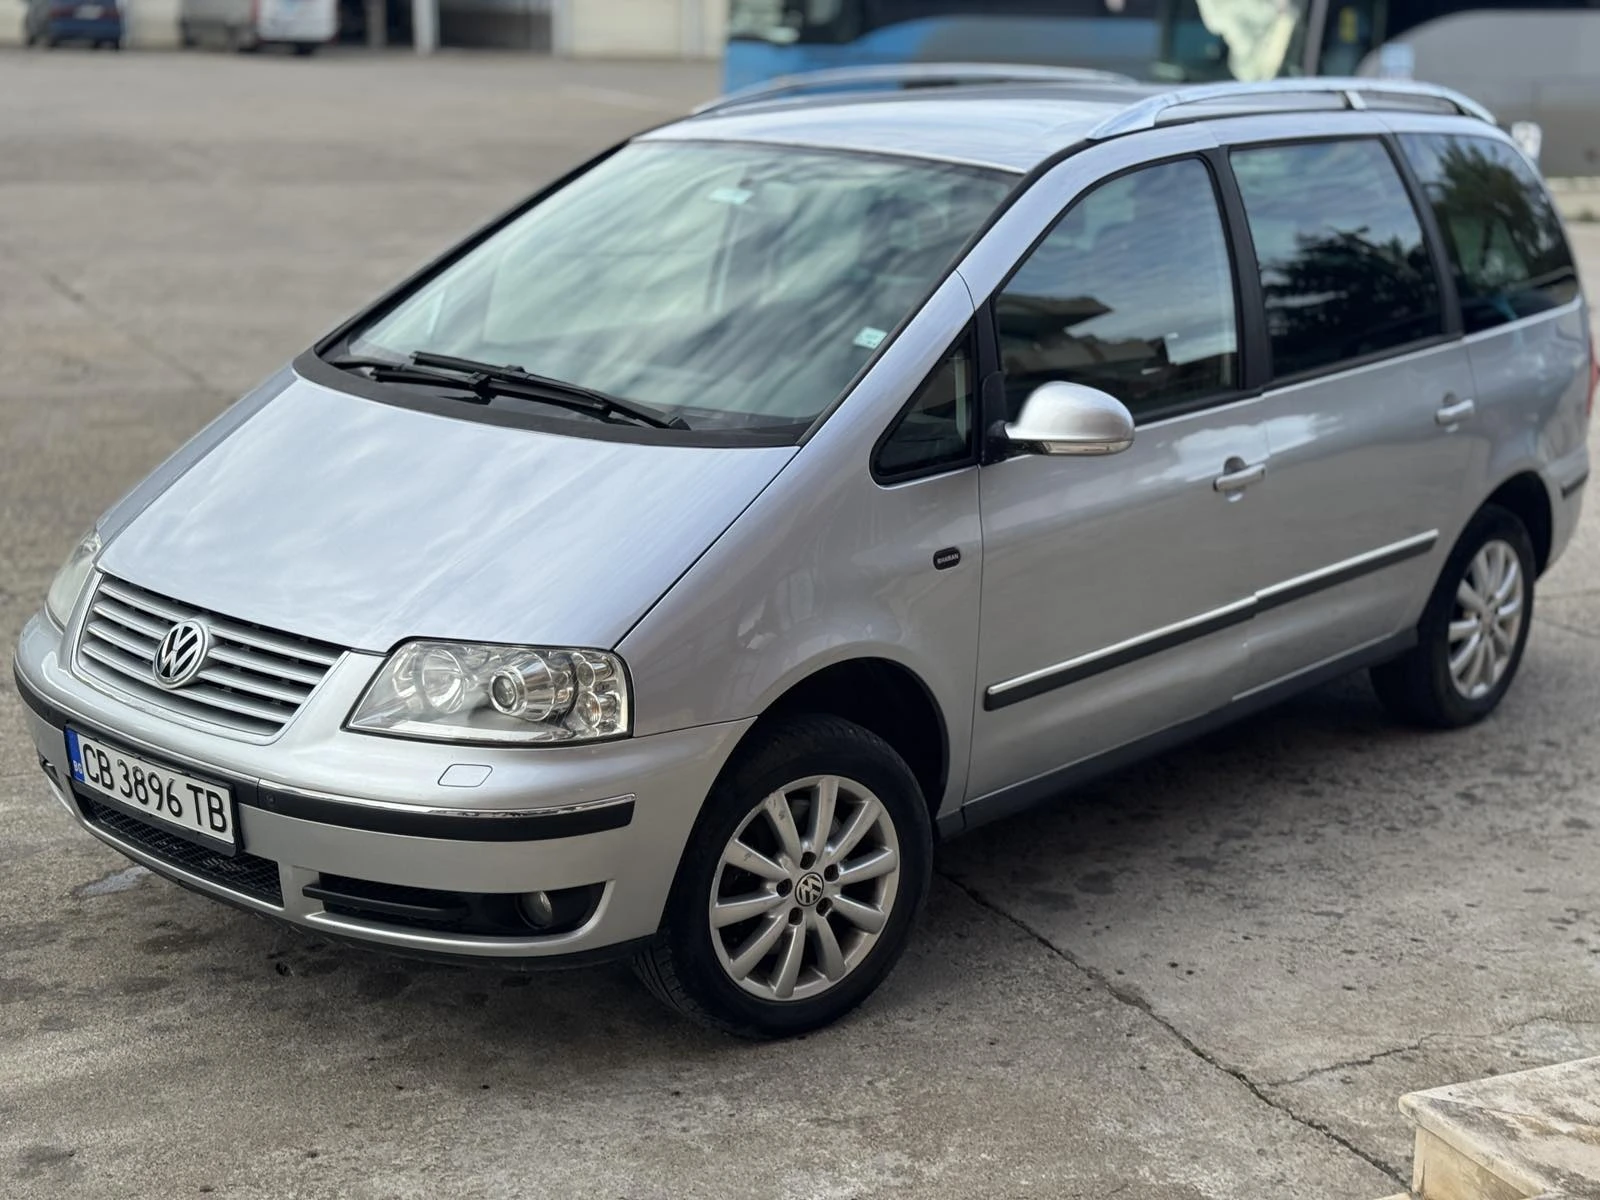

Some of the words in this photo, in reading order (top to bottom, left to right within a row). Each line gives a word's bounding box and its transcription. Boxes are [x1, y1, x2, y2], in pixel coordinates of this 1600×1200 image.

[155, 621, 204, 684] VW
[73, 760, 83, 774] BG
[83, 743, 114, 790] CB
[117, 759, 183, 818] 3896
[187, 783, 227, 833] TB
